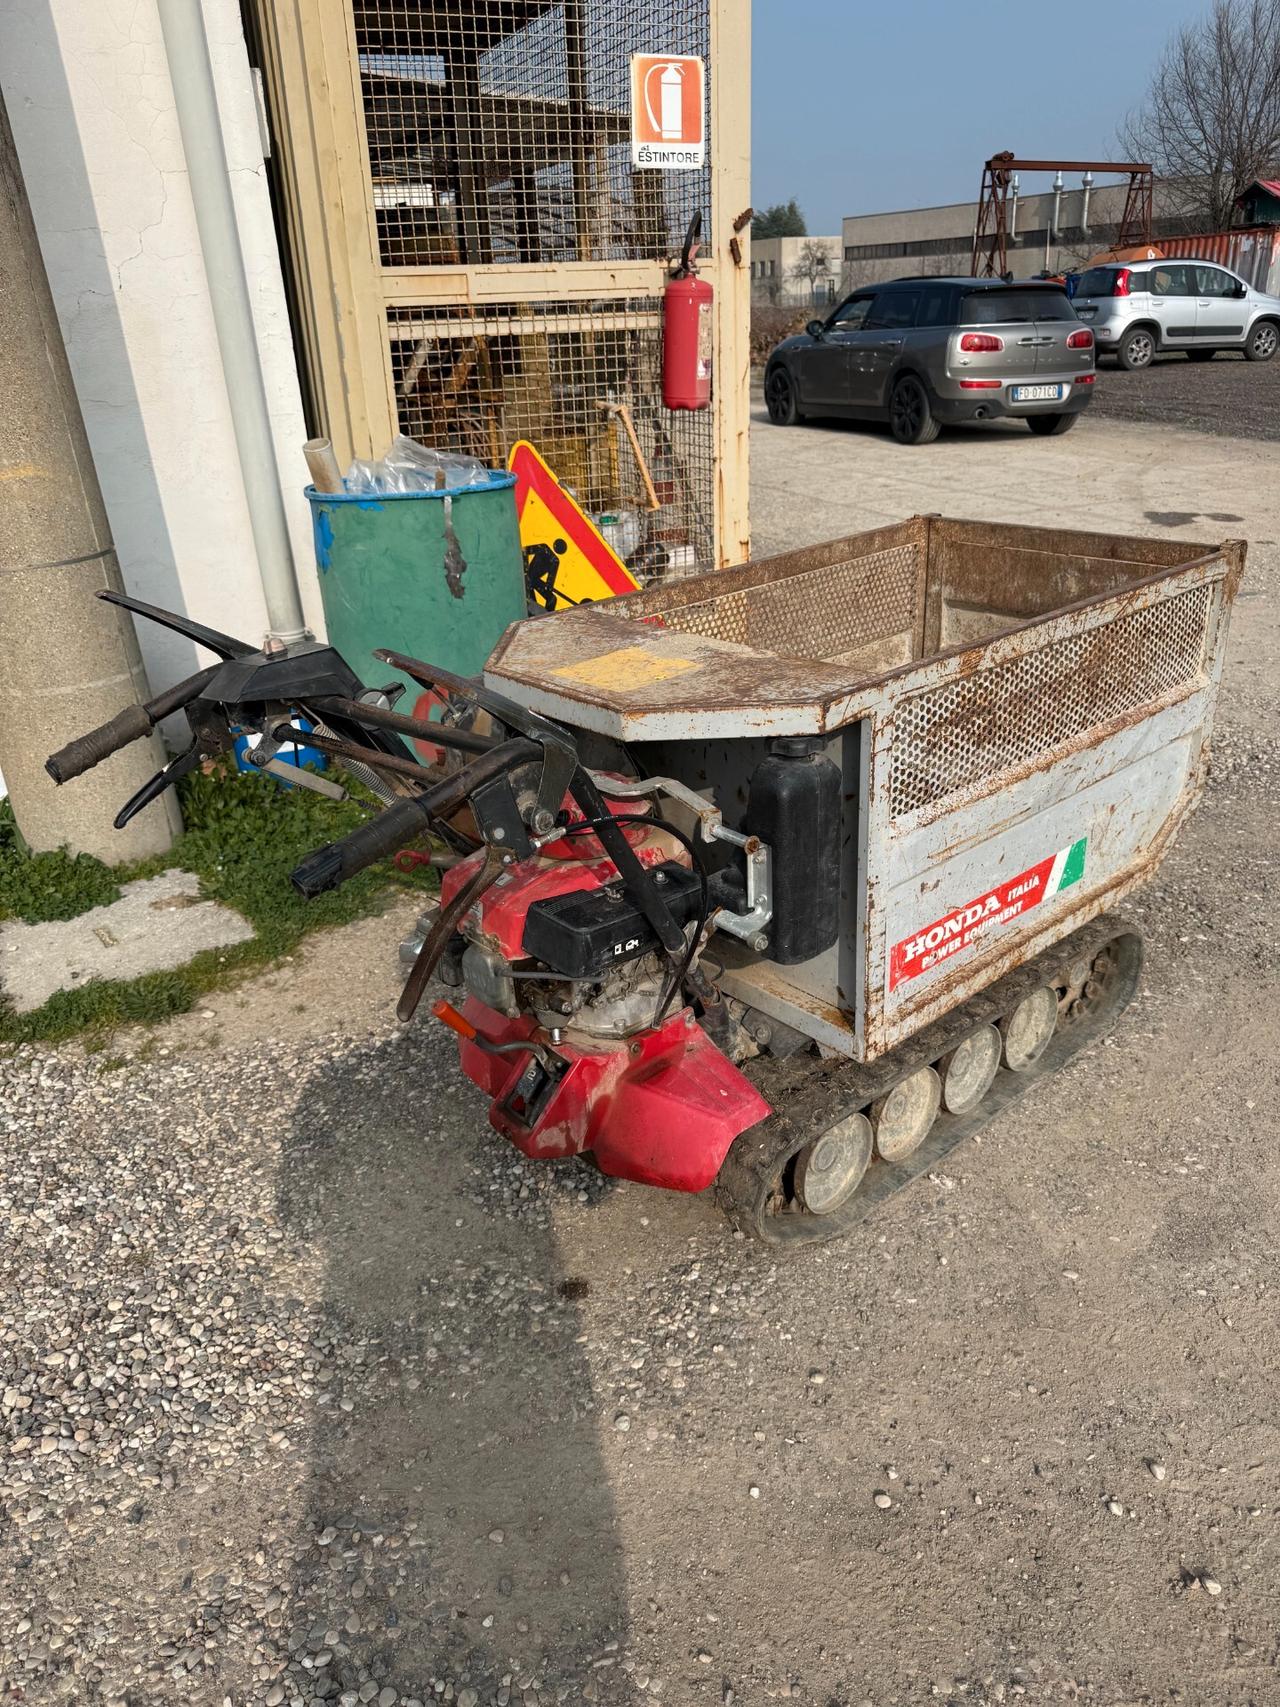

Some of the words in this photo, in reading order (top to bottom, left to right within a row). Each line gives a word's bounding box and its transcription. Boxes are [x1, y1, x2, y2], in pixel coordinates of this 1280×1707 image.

[638, 151, 700, 163] ESTINTORE
[904, 895, 1001, 962] HONDA
[1007, 876, 1040, 902] ITALIA
[963, 900, 1023, 944] EQUIPMENT
